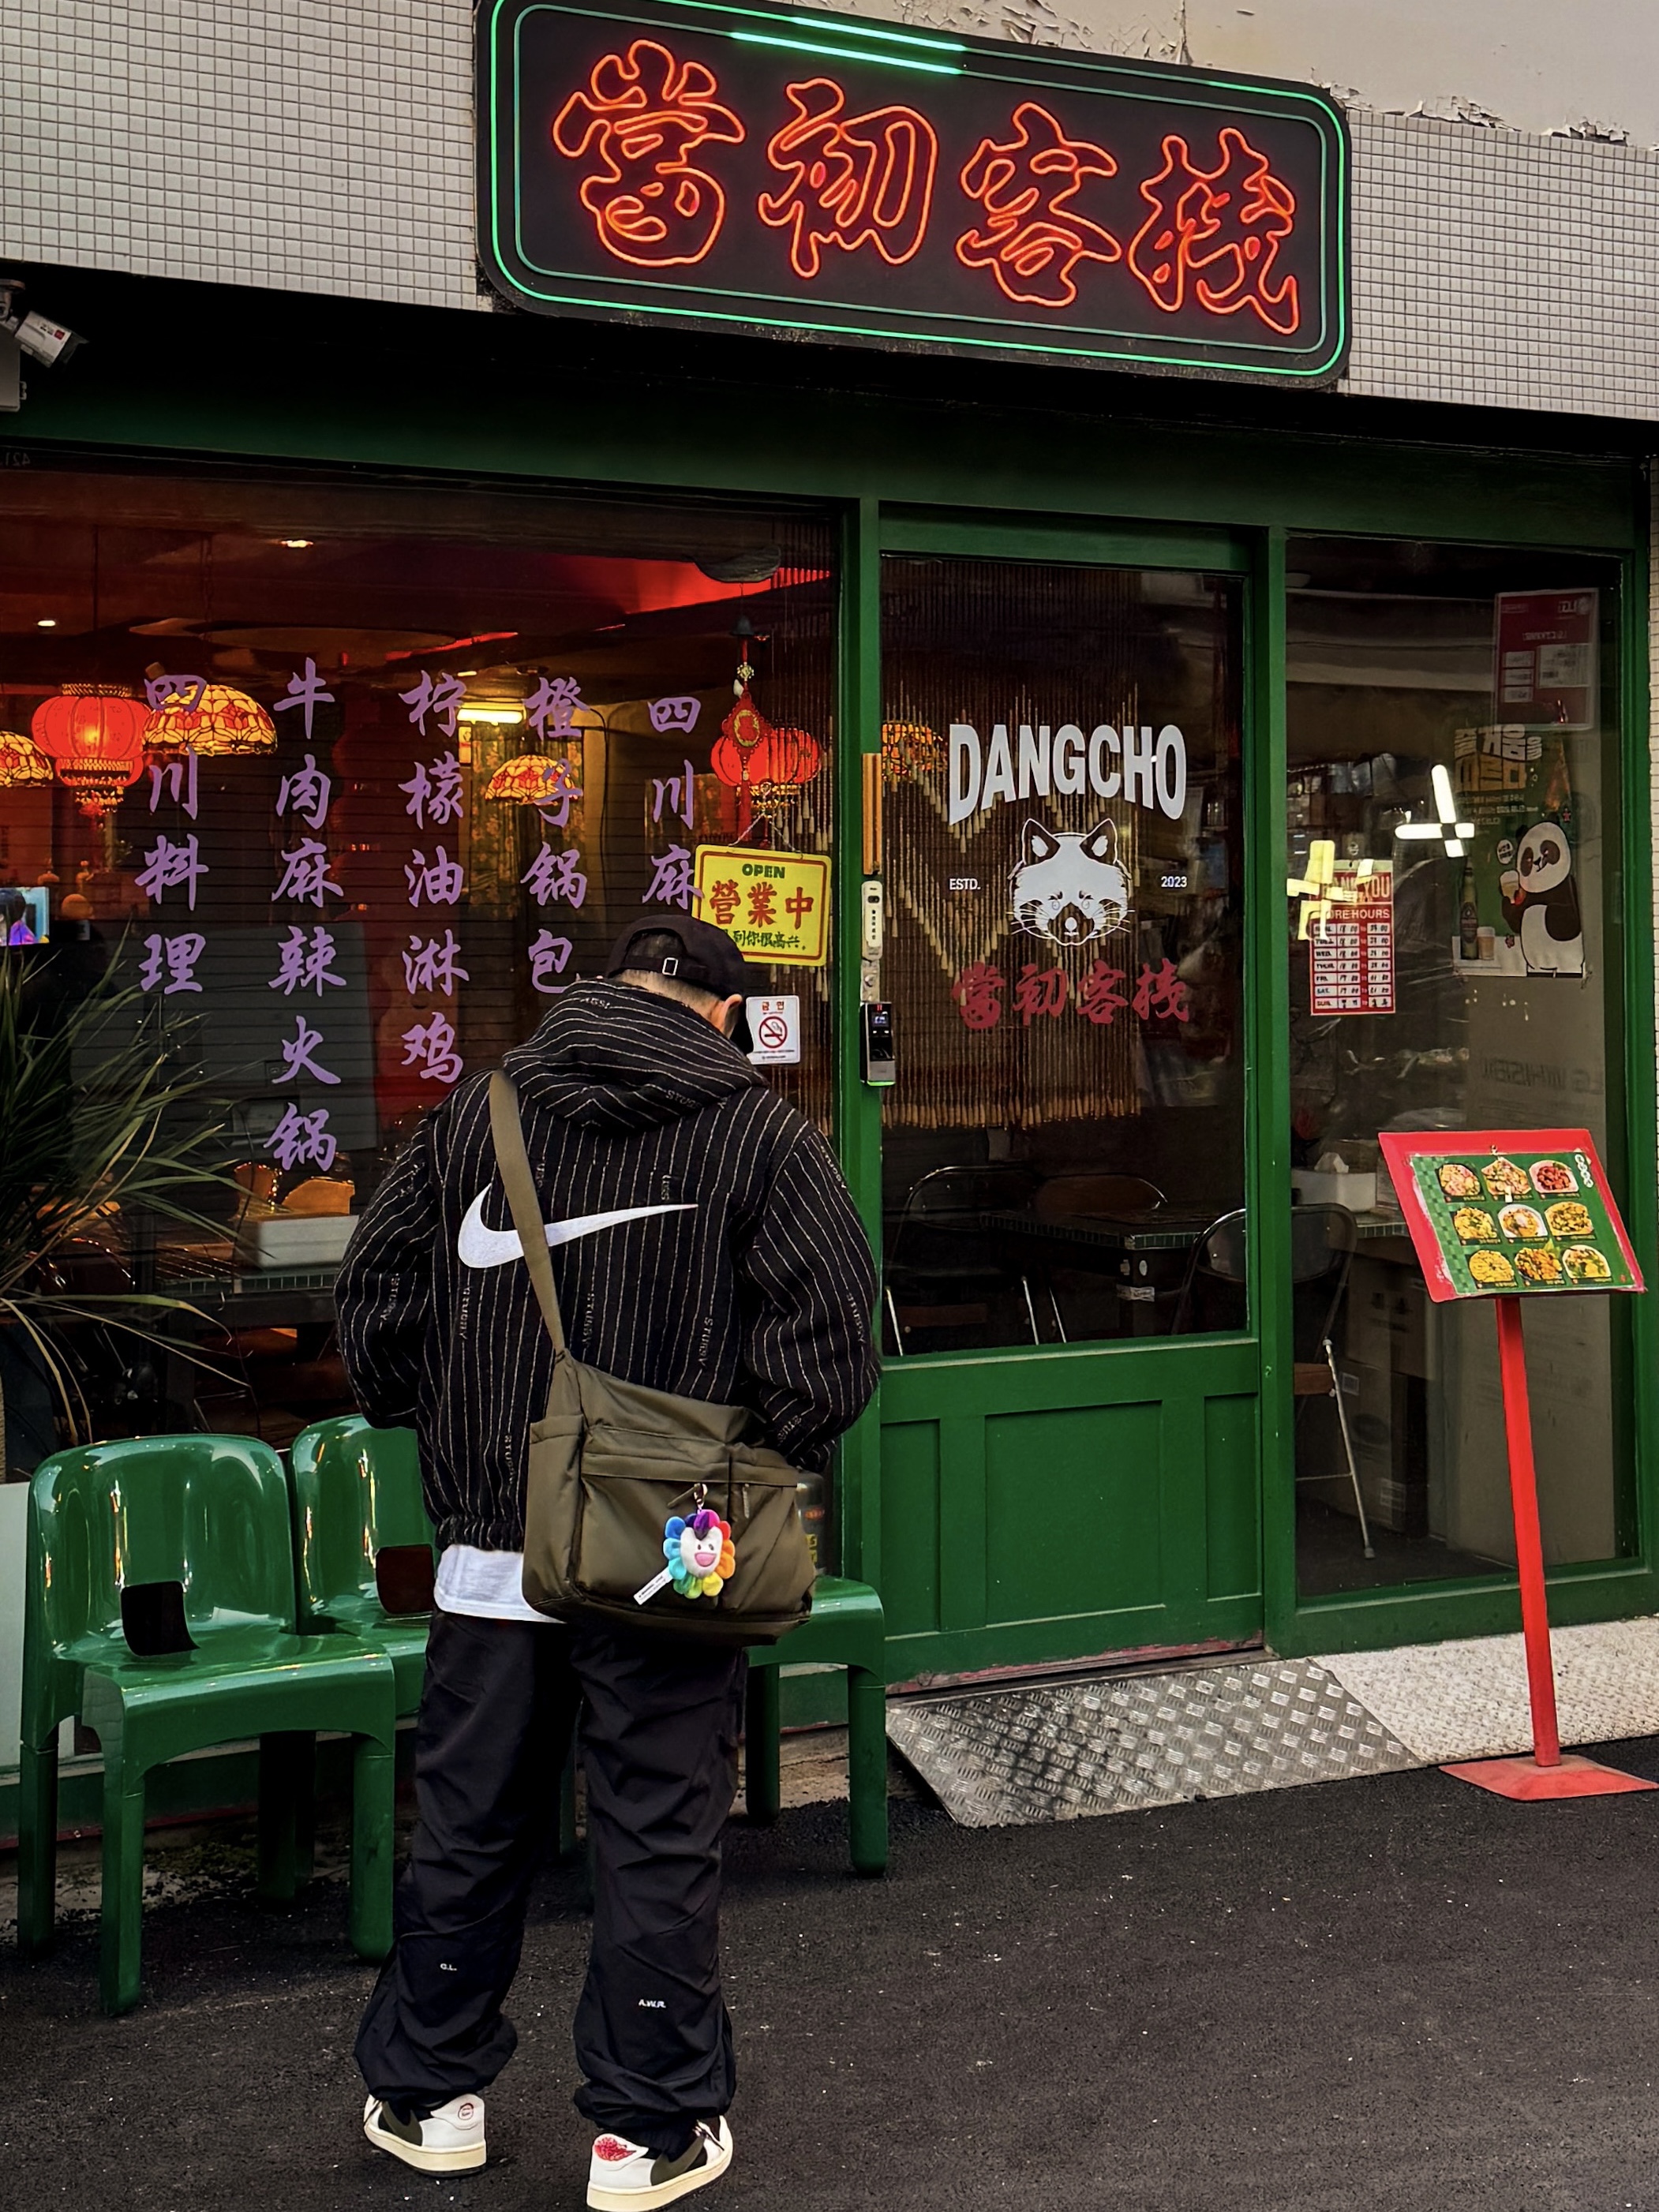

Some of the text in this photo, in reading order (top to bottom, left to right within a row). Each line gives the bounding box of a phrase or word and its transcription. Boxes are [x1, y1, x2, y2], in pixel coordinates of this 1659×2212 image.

[948, 724, 1187, 826] DANGCHO
[134, 673, 209, 995] 四川料理
[742, 863, 785, 878] OPEN
[263, 657, 347, 1172] 牛肉麻辣火锅
[398, 670, 470, 1084] 柠檬油淋鸡
[709, 878, 815, 930] 營業中
[949, 876, 1187, 890] ESTD. 2023
[1351, 908, 1391, 919] HOURS
